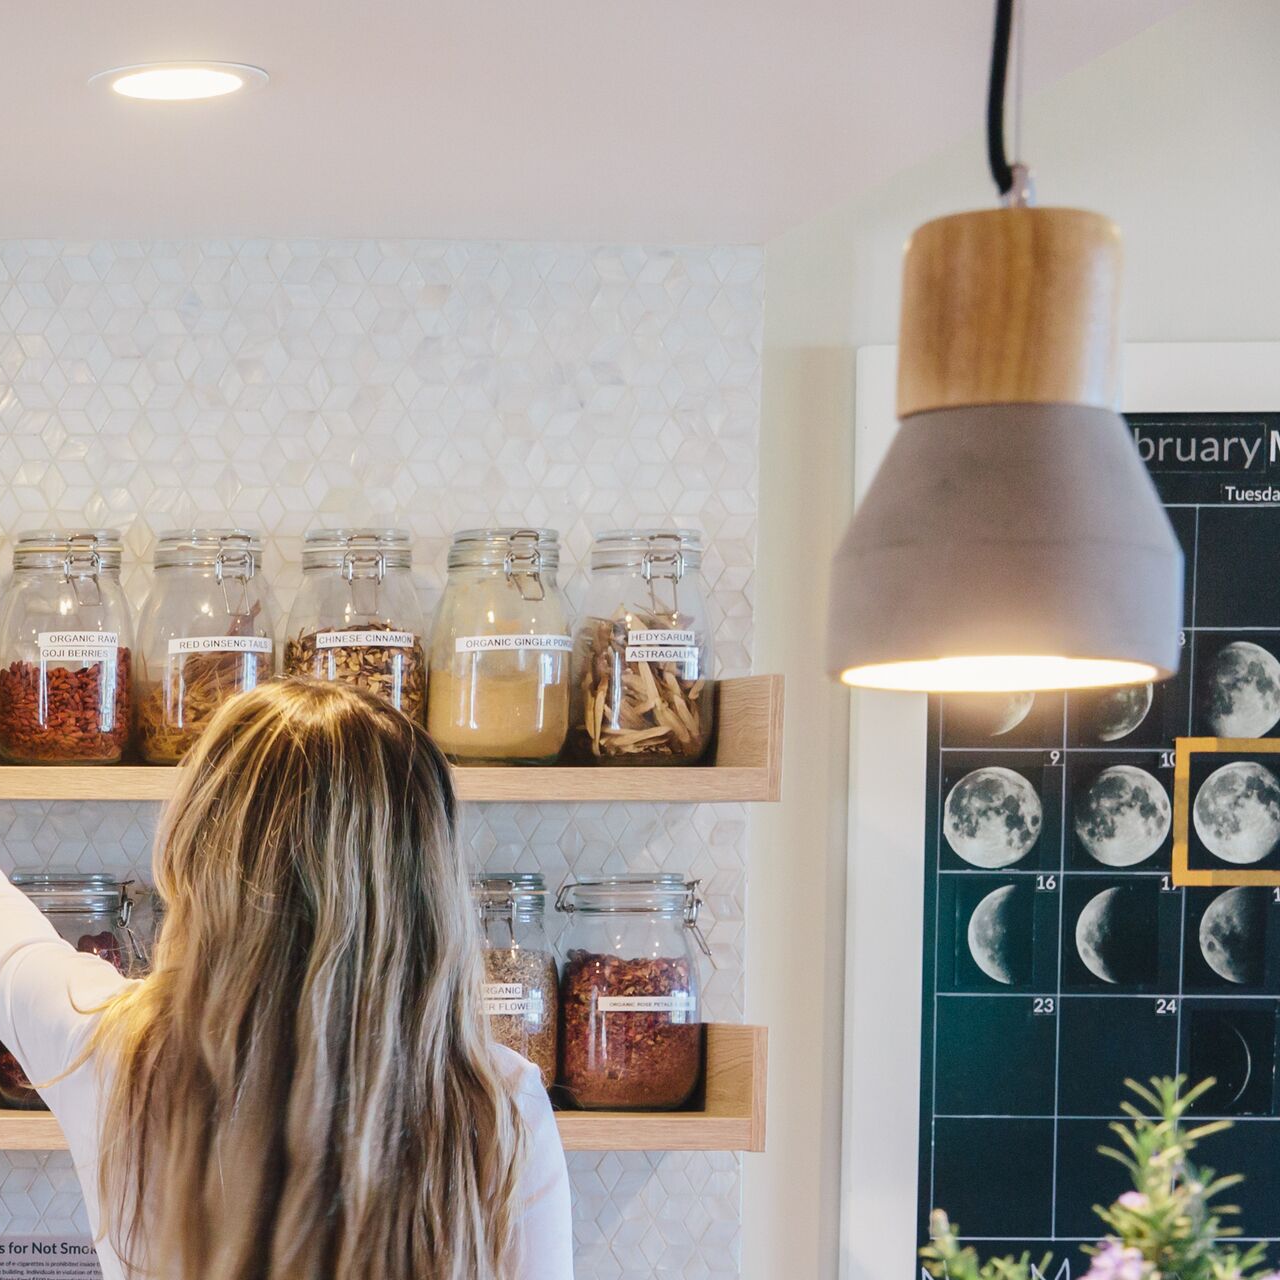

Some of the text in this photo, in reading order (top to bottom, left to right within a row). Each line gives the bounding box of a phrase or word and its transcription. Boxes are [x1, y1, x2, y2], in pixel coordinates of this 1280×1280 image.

[1134, 428, 1262, 469] bruary
[49, 635, 117, 644] ORGANIC RAW
[318, 634, 412, 644] CHINESE CINNAMON
[631, 633, 693, 642] HEDYSARUM
[179, 641, 200, 649] RED
[202, 640, 247, 649] GINSENG
[465, 639, 511, 648] ORGANIC
[514, 638, 552, 647] GINGER
[42, 649, 108, 658] GOJI BERRIES
[1050, 751, 1060, 766] 9
[1036, 875, 1056, 890] 16
[1161, 876, 1177, 891] 1
[485, 986, 521, 994] RGANIC
[1034, 999, 1177, 1014] 23 24
[8, 1241, 28, 1254] for
[31, 1242, 57, 1254] Not
[60, 1242, 97, 1255] Smok
